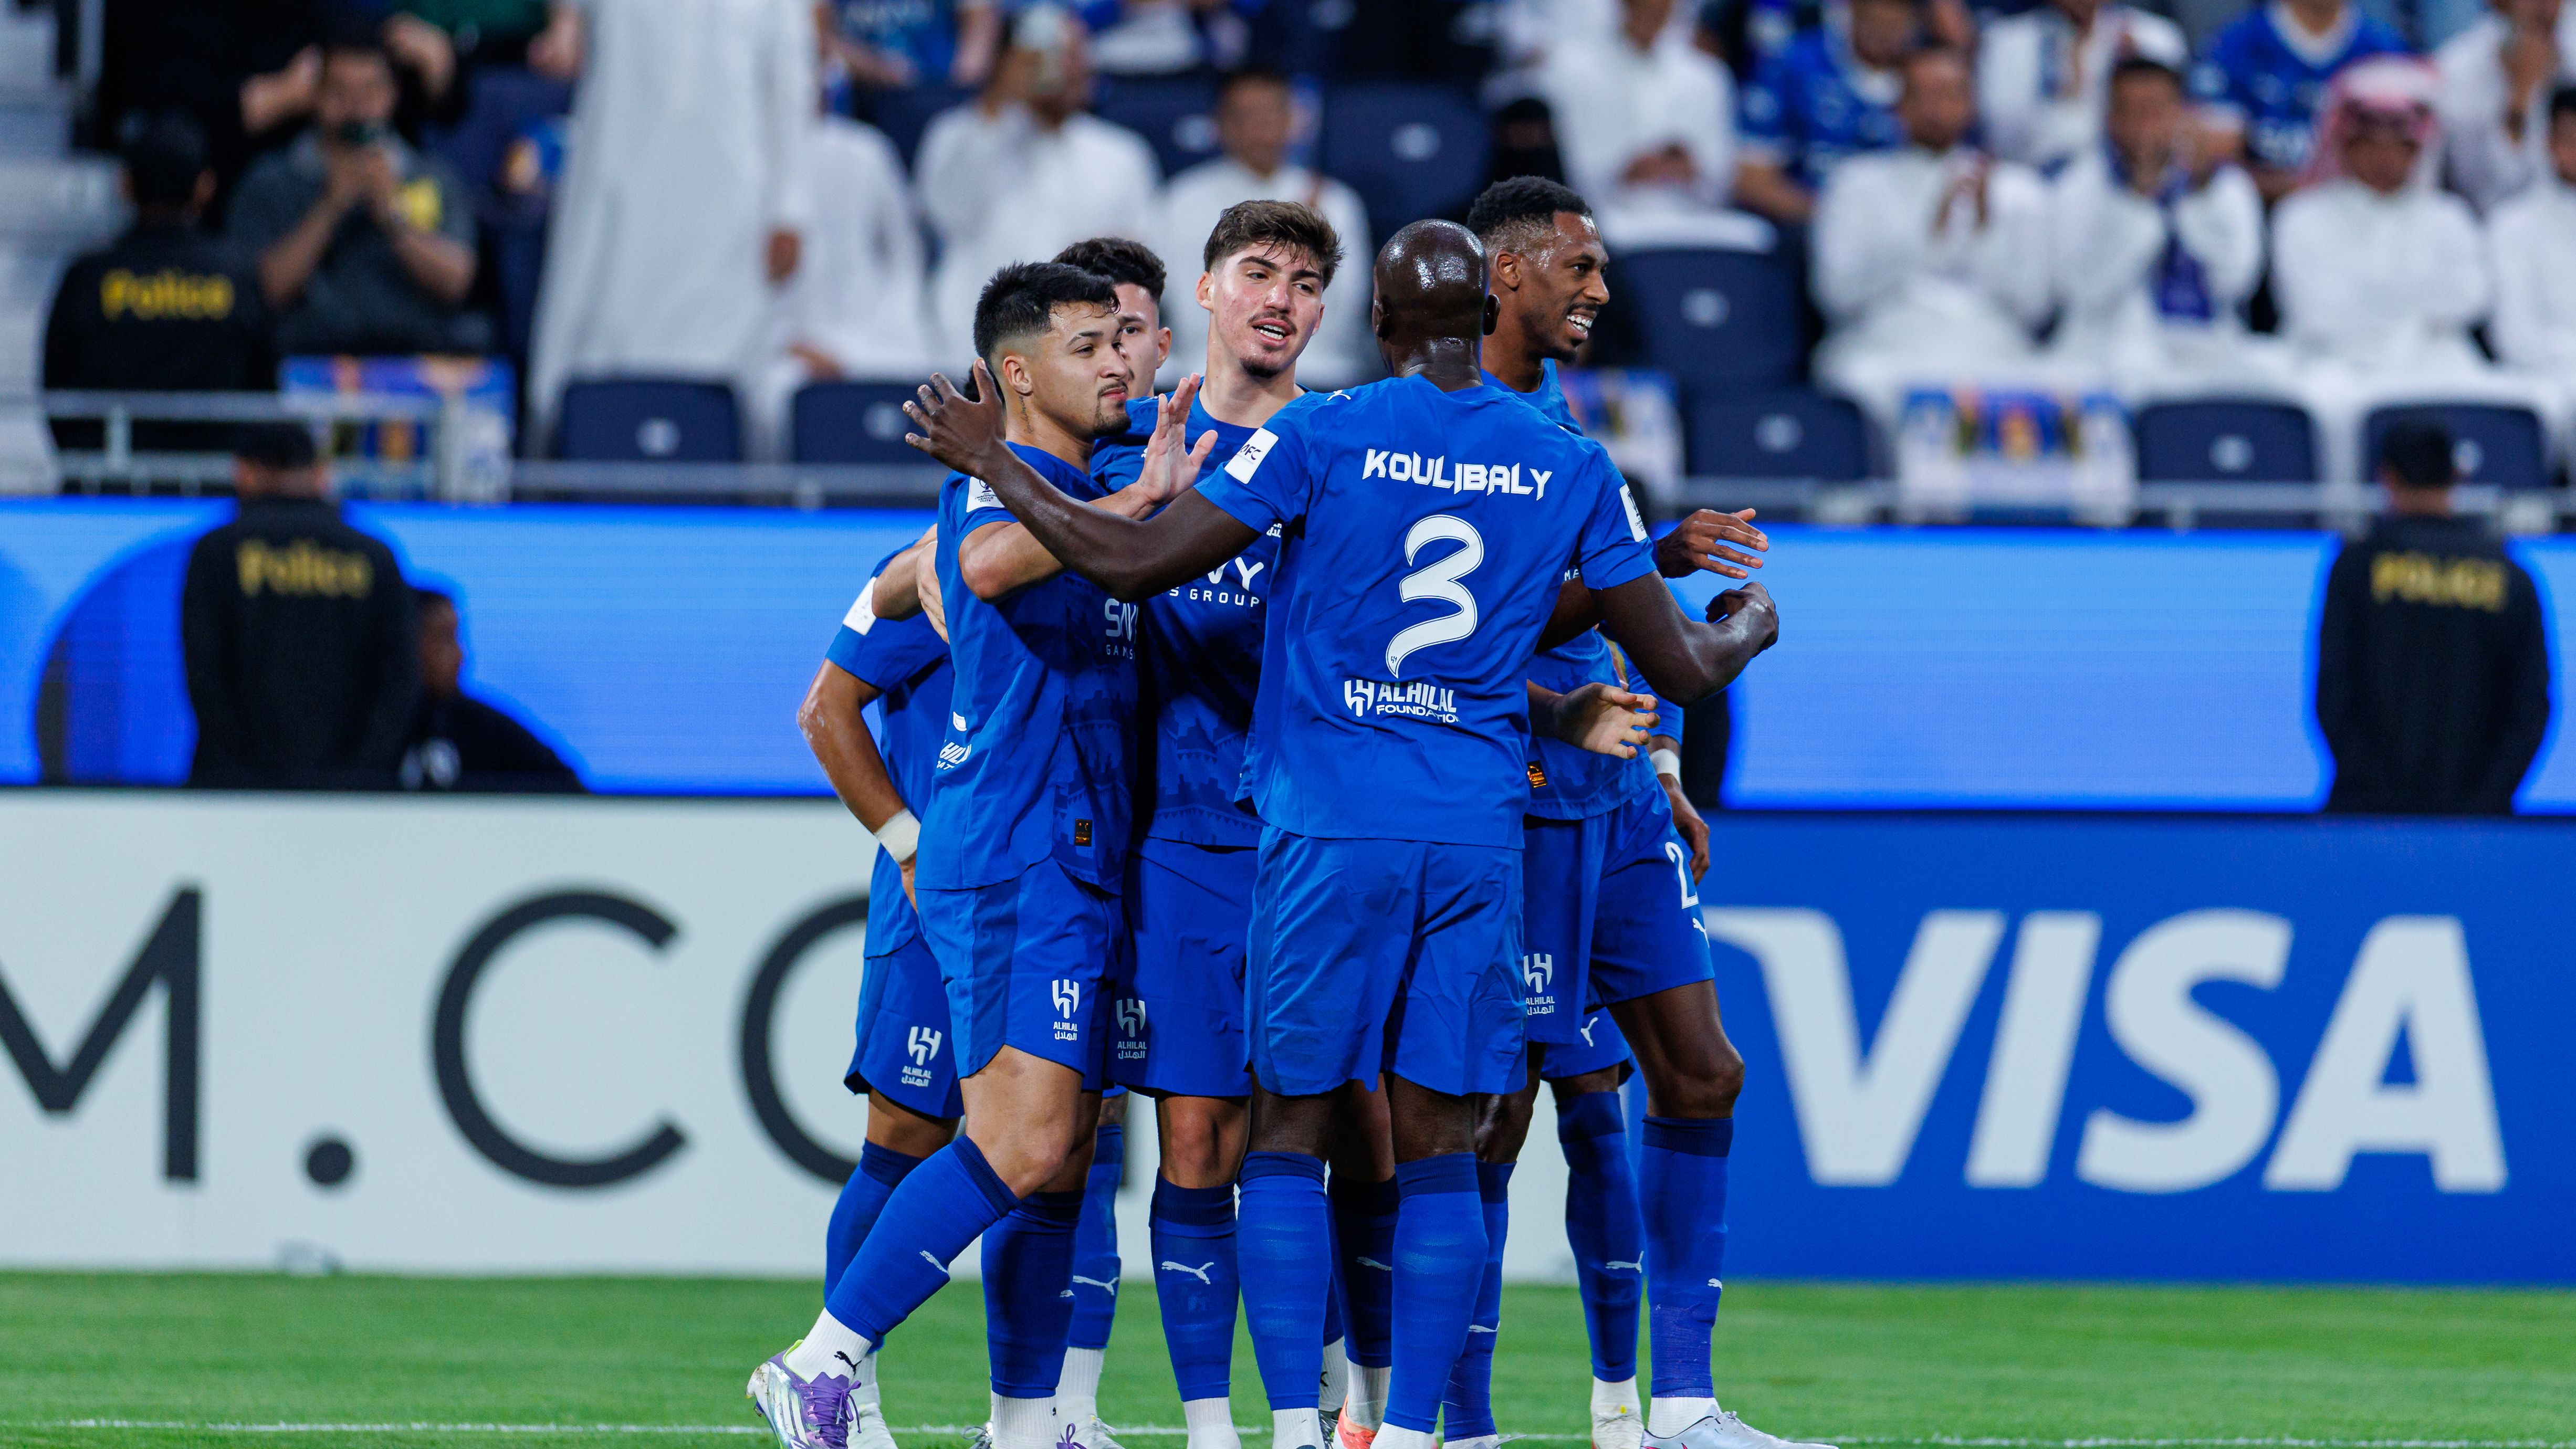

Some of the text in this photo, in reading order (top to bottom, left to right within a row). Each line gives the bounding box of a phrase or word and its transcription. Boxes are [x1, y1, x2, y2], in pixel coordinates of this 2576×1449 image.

[1240, 444, 1262, 460] AFC
[1363, 448, 1553, 500] KOULIBALY
[1190, 589, 1260, 607] GROUP
[1385, 514, 1484, 678] 3
[1377, 681, 1457, 713] ALHILAL
[1525, 995, 1555, 1005] ALHILAL
[1053, 1021, 1078, 1032] ALHILAL
[1117, 1041, 1147, 1049] ALHILAL
[1706, 908, 2508, 1192] VISA
